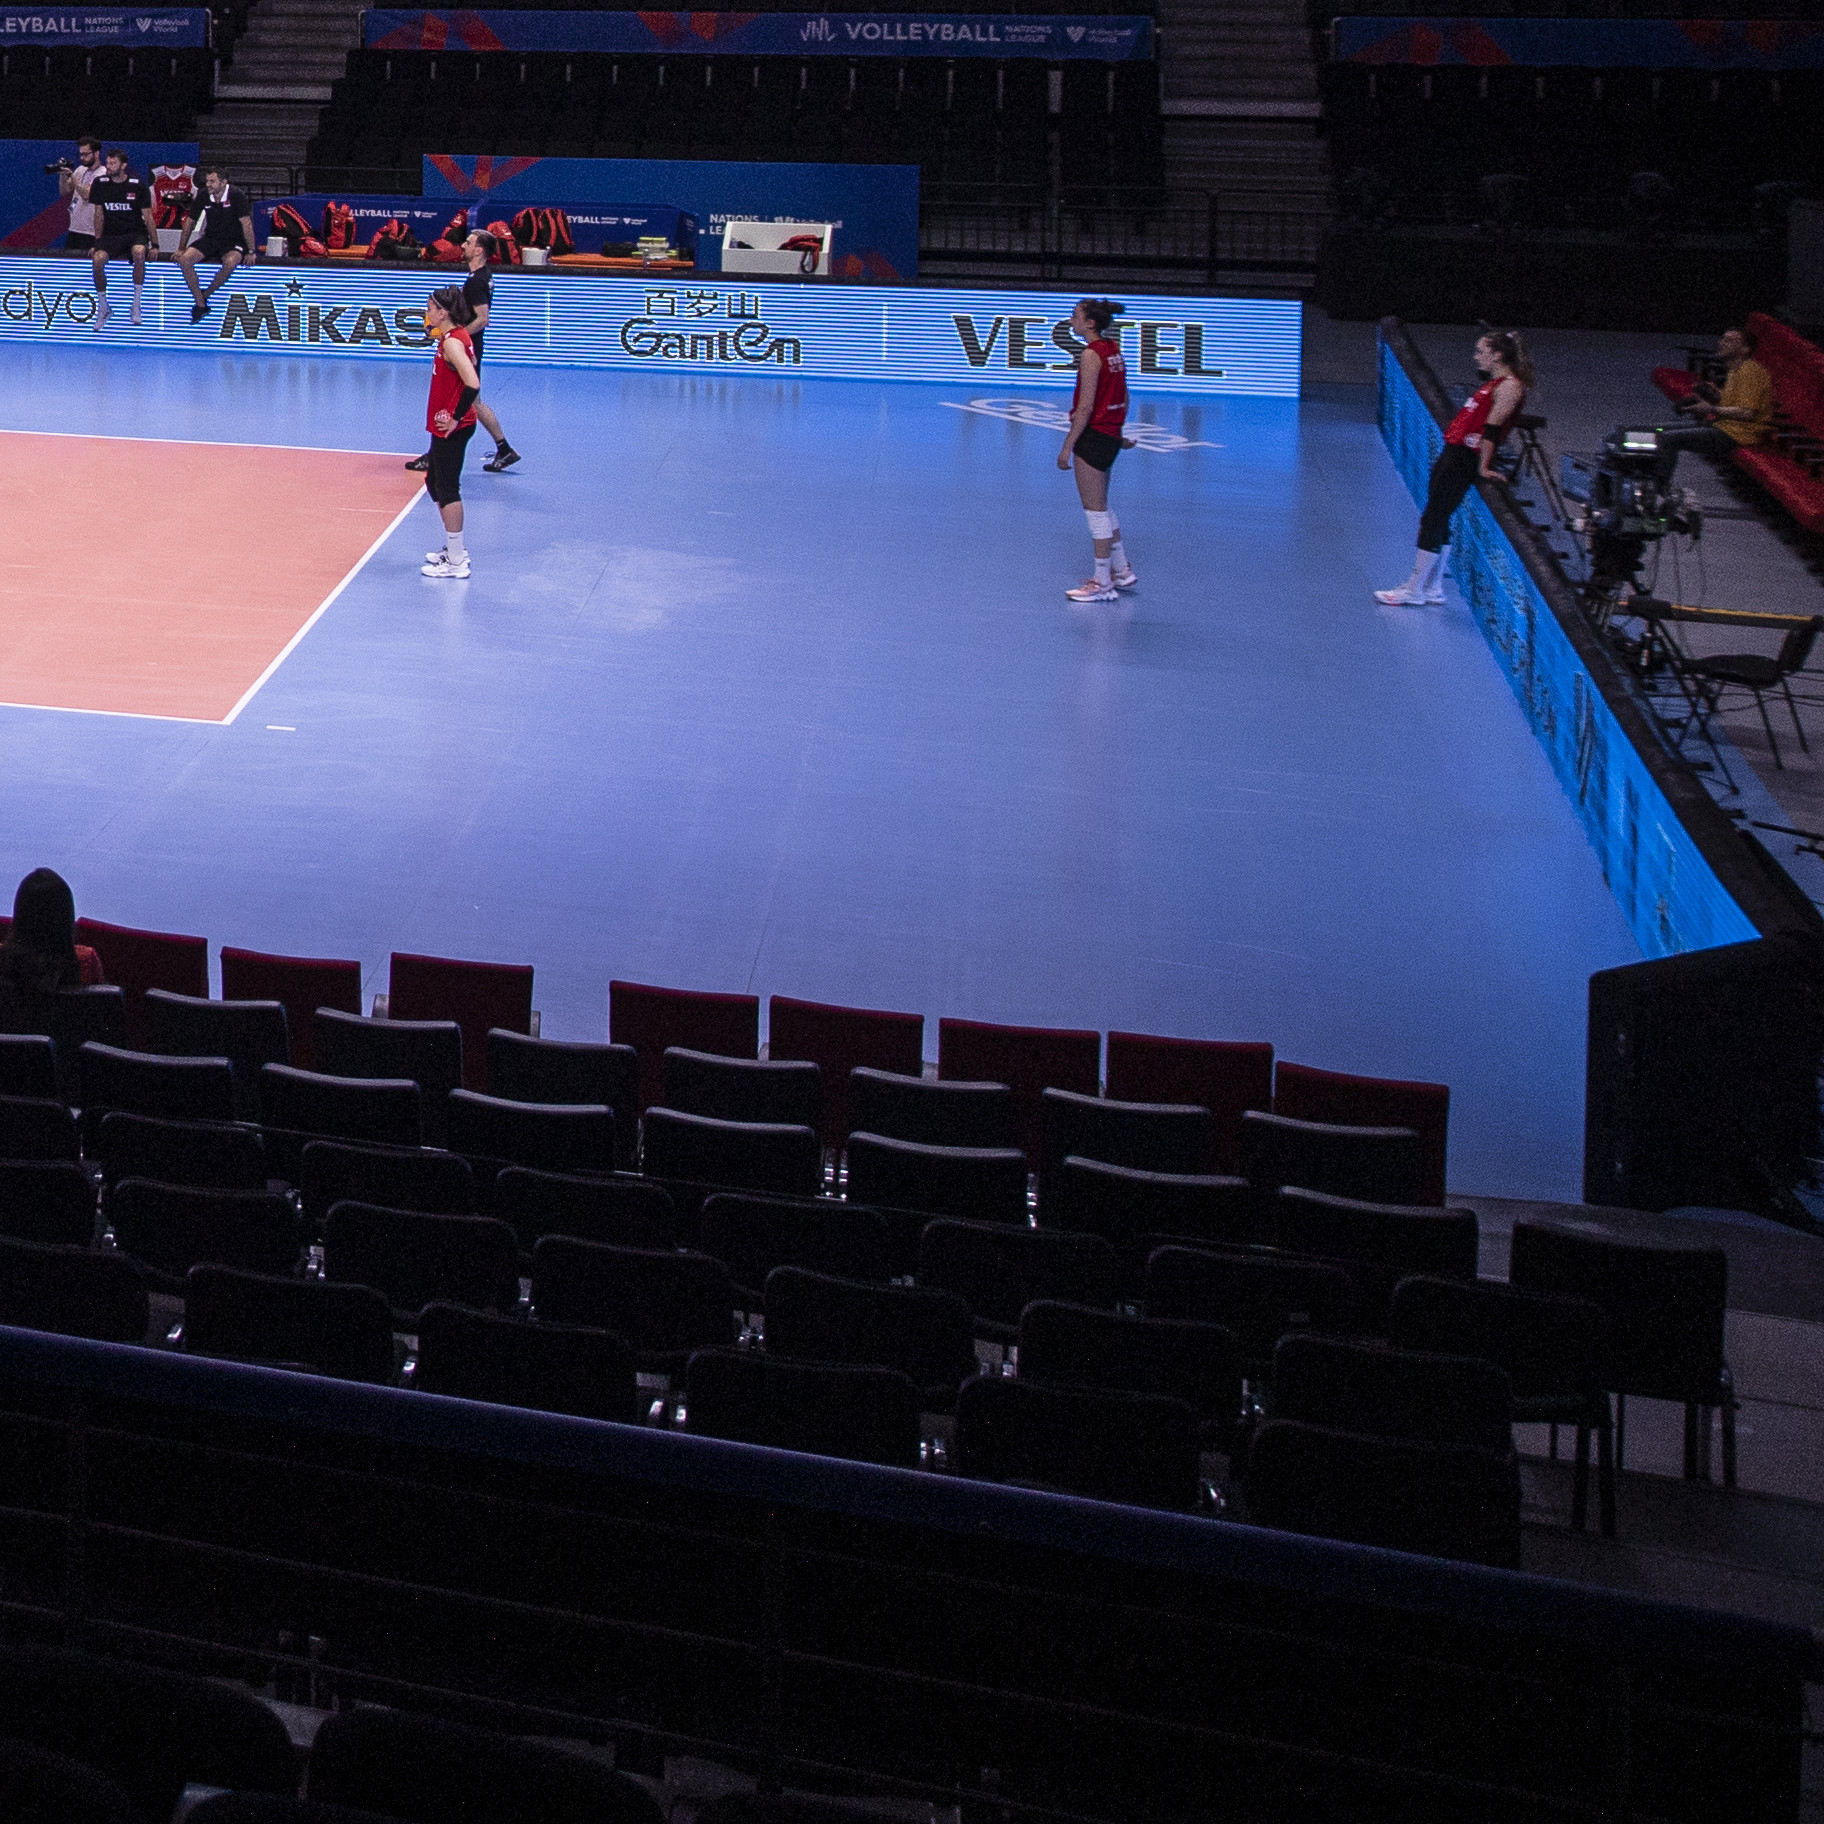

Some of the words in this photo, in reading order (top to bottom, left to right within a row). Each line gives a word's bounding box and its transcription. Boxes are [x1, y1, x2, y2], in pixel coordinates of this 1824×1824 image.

[84, 17, 124, 26] NATIONS
[85, 25, 120, 34] LEAGUE
[845, 21, 1001, 43] VOLLEYBALL
[104, 202, 133, 211] VESTEL
[350, 208, 392, 218] LLEYBALL
[566, 215, 601, 225] EYBALL
[644, 288, 761, 319] 百岁山
[218, 277, 437, 348] MiKAS
